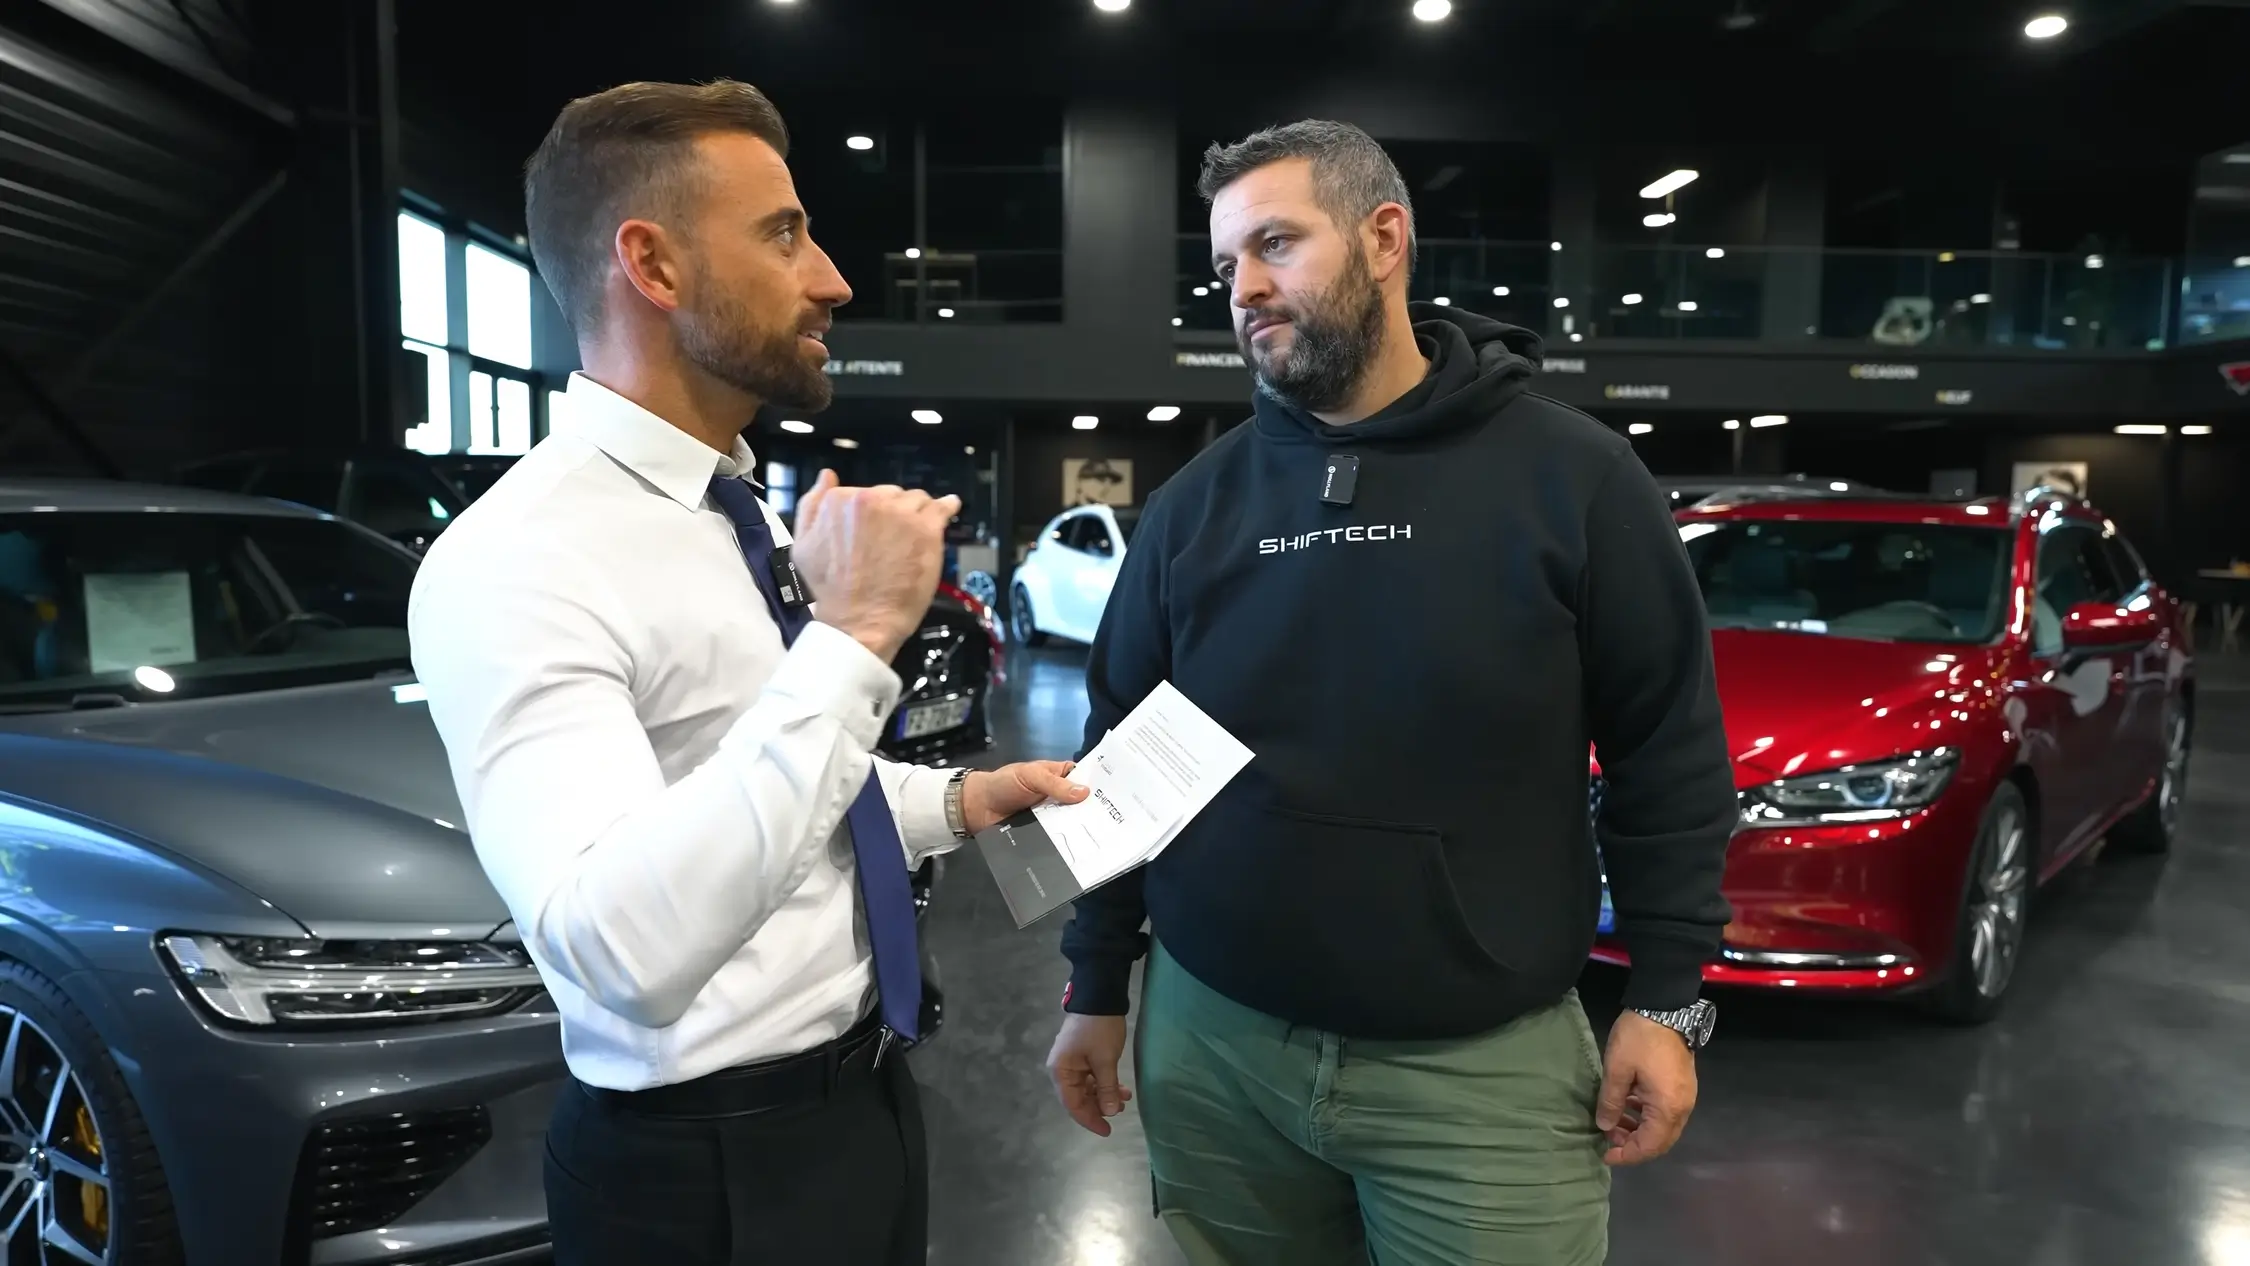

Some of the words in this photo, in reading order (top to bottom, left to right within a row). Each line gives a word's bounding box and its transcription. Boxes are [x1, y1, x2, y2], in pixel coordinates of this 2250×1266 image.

[1542, 358, 1586, 373] EPRISE
[1849, 363, 1919, 380] OCCASION
[1605, 385, 1670, 400] GARANTIE
[1259, 524, 1412, 554] SHIFTECH
[1094, 788, 1125, 825] SHIFTECH
